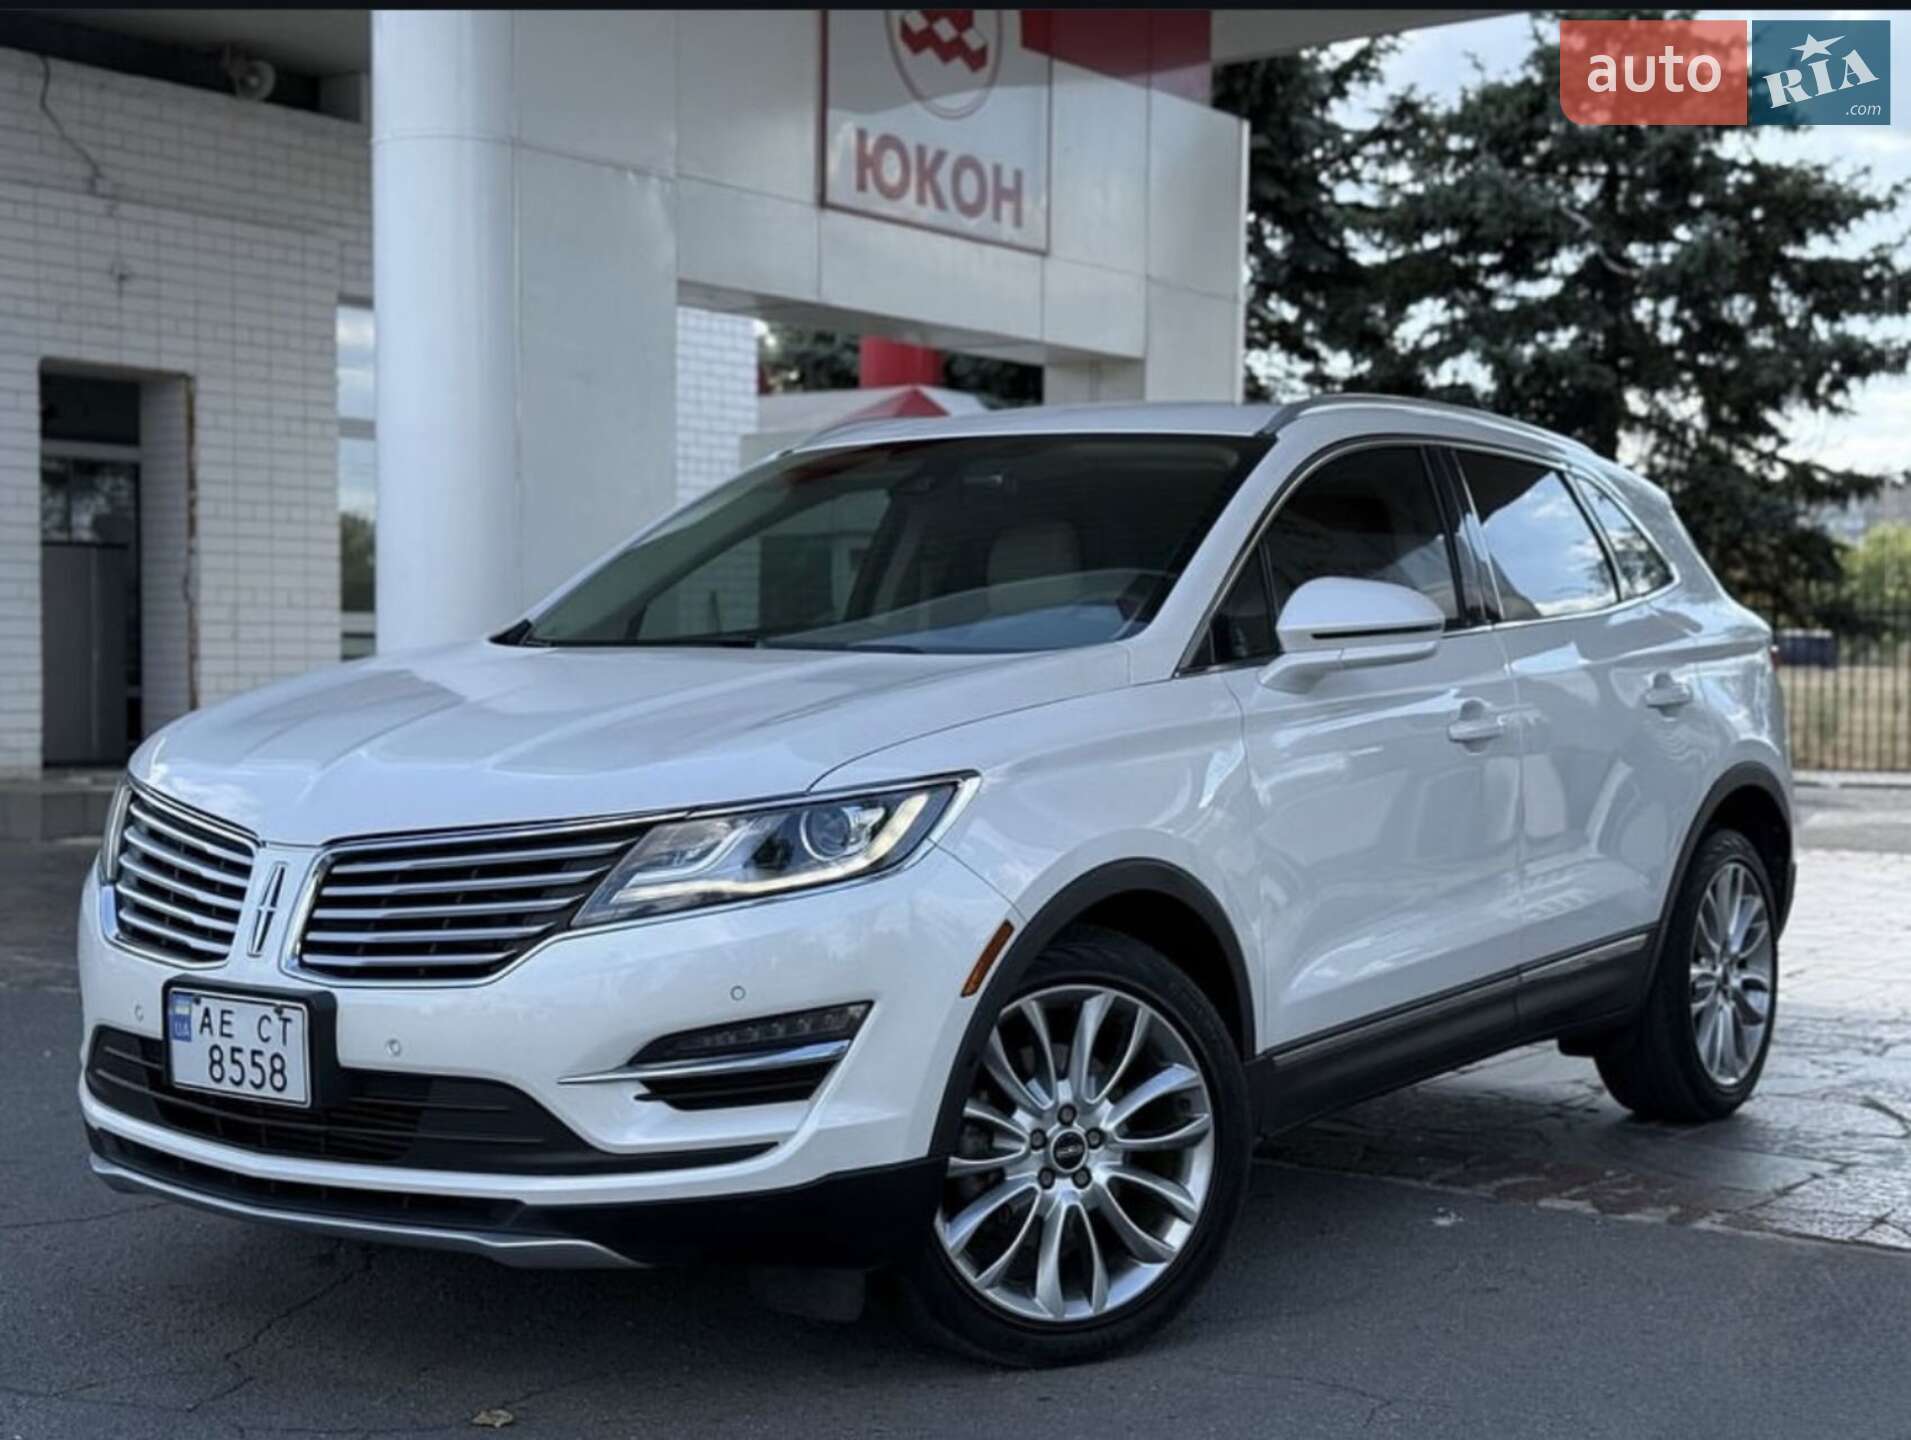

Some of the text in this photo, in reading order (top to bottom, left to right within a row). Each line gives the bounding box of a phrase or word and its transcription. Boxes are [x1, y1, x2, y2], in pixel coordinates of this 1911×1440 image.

[856, 127, 1023, 229] ЮКОН
[200, 1006, 293, 1046] AE CT
[208, 1044, 288, 1093] 8558
